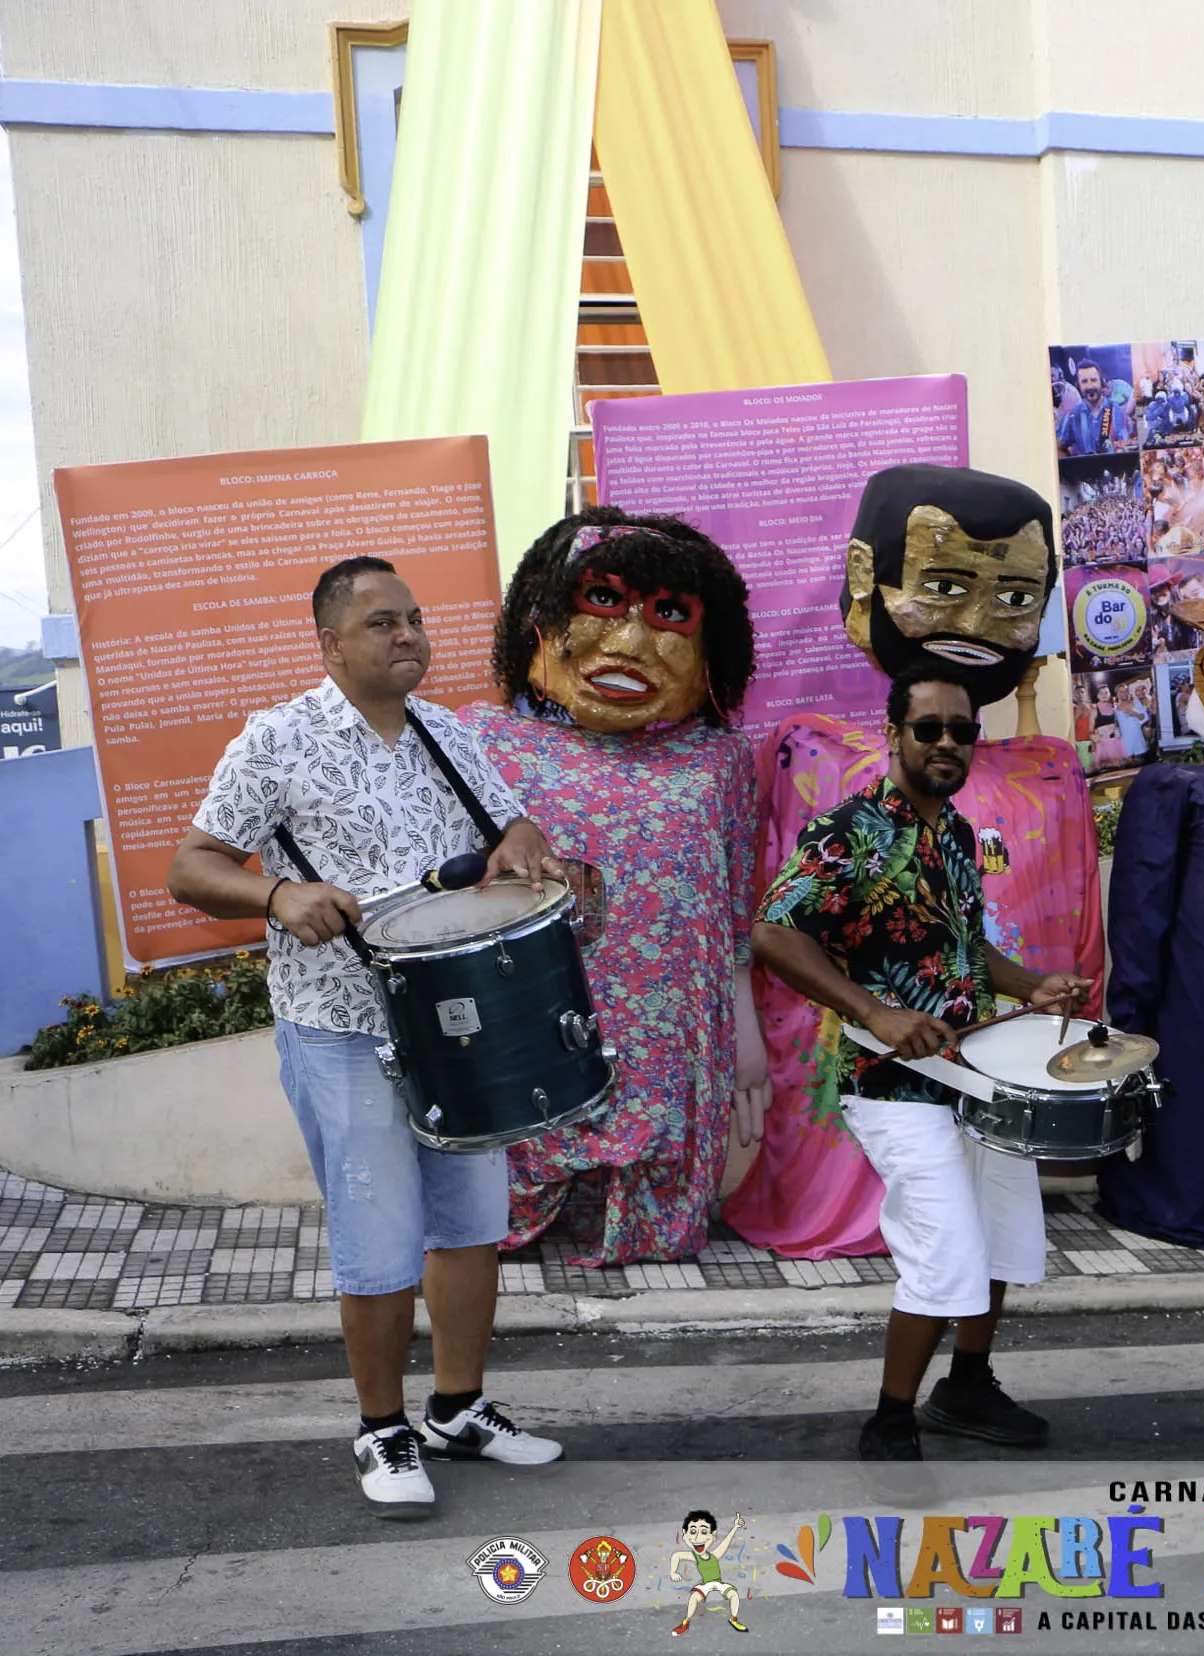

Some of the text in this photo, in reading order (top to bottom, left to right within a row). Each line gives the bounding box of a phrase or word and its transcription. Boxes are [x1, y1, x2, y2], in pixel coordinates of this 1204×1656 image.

[744, 397, 772, 405] BLOCO:
[220, 469, 338, 486] BLOCO: IMPINA CARROÇA
[759, 518, 786, 527] BLOCO:
[193, 600, 227, 611] ESCOLA
[229, 598, 241, 607] DE
[243, 595, 277, 606] SAMBA:
[1102, 601, 1126, 613] Bar
[1094, 612, 1112, 624] do
[766, 693, 832, 708] BLOCO: BATE LATA
[1, 717, 43, 736] aqui!
